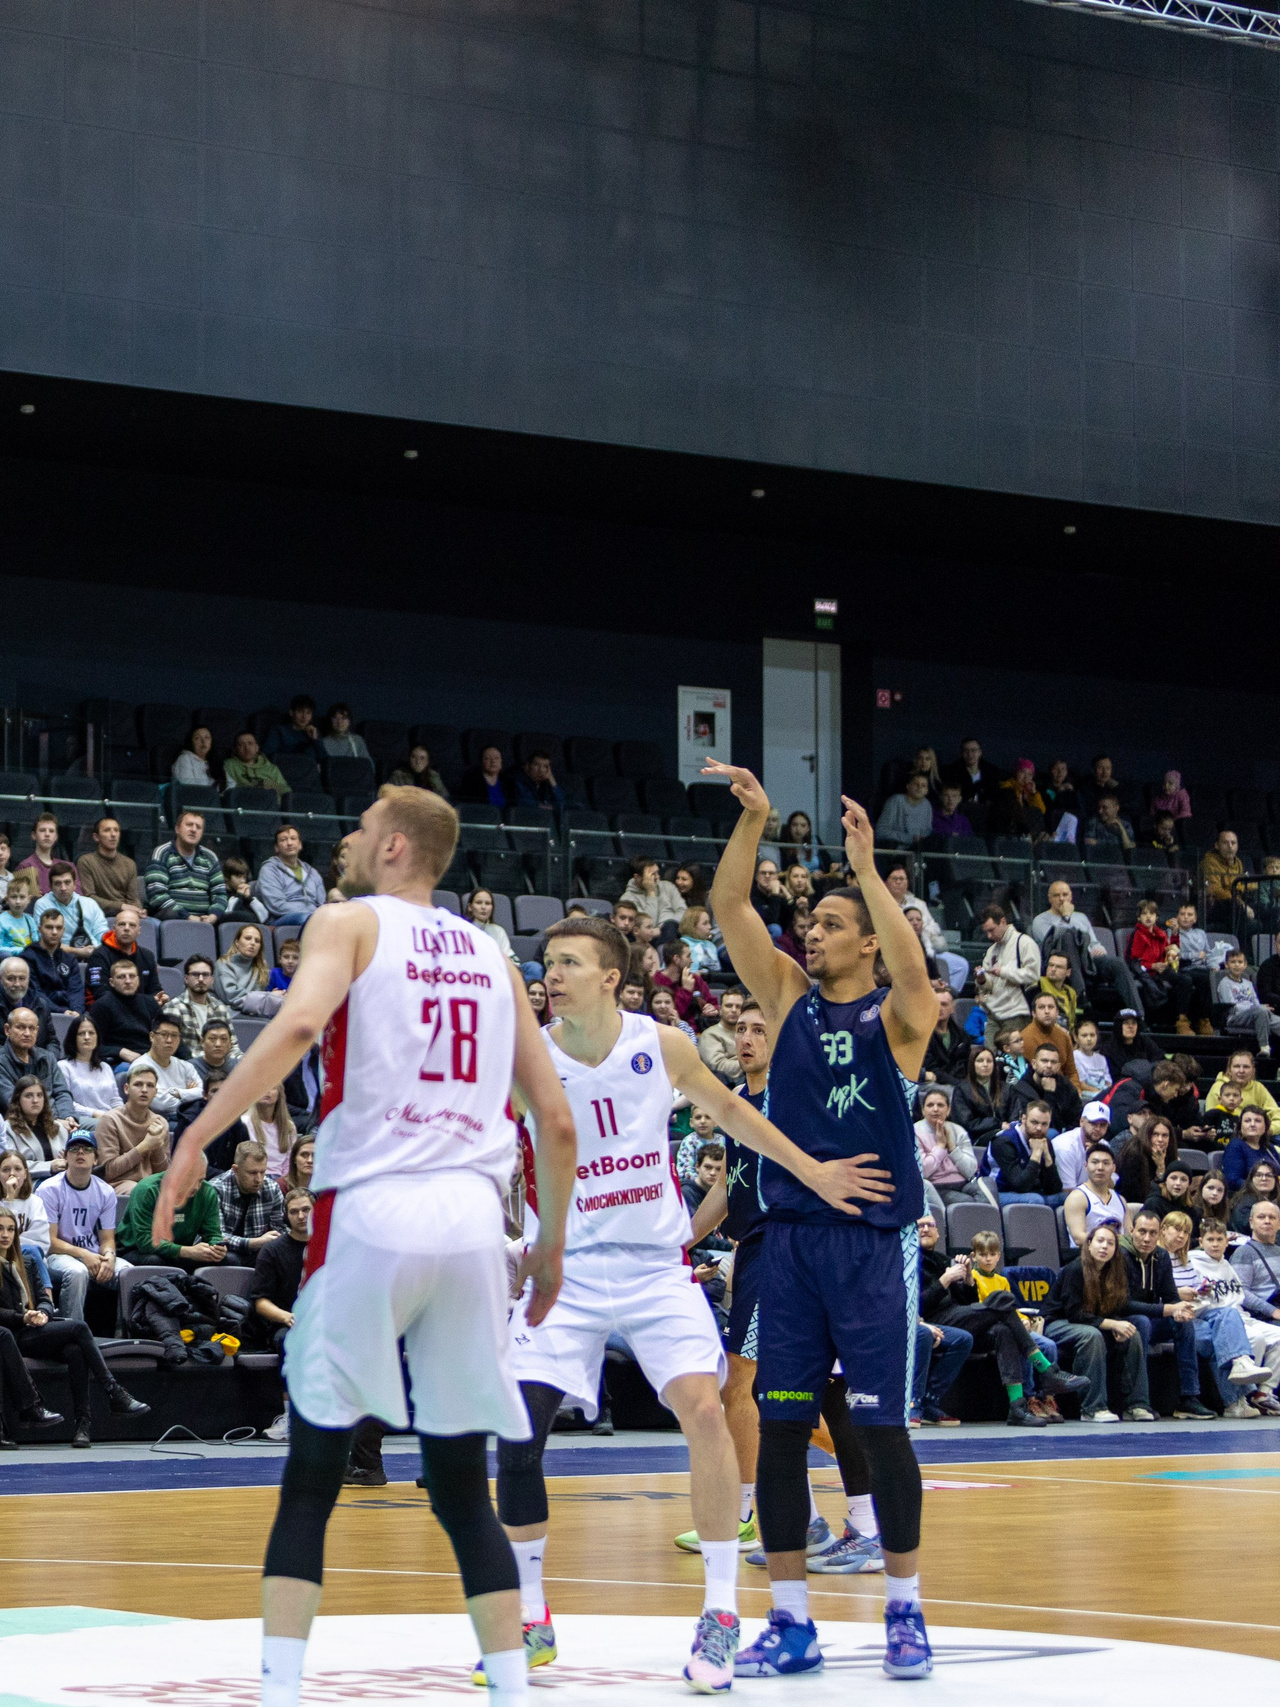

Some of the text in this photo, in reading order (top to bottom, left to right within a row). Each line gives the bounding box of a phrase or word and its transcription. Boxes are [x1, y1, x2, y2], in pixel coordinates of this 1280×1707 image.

[419, 997, 478, 1083] 28
[820, 1030, 854, 1065] 33
[590, 1097, 618, 1138] 11
[576, 1151, 660, 1179] etBoom
[584, 1183, 663, 1212] МОСИНЖПРОЕКТ
[72, 1207, 88, 1227] 77
[1018, 1281, 1049, 1301] VIP
[60, 1664, 607, 1698] TACTORS
